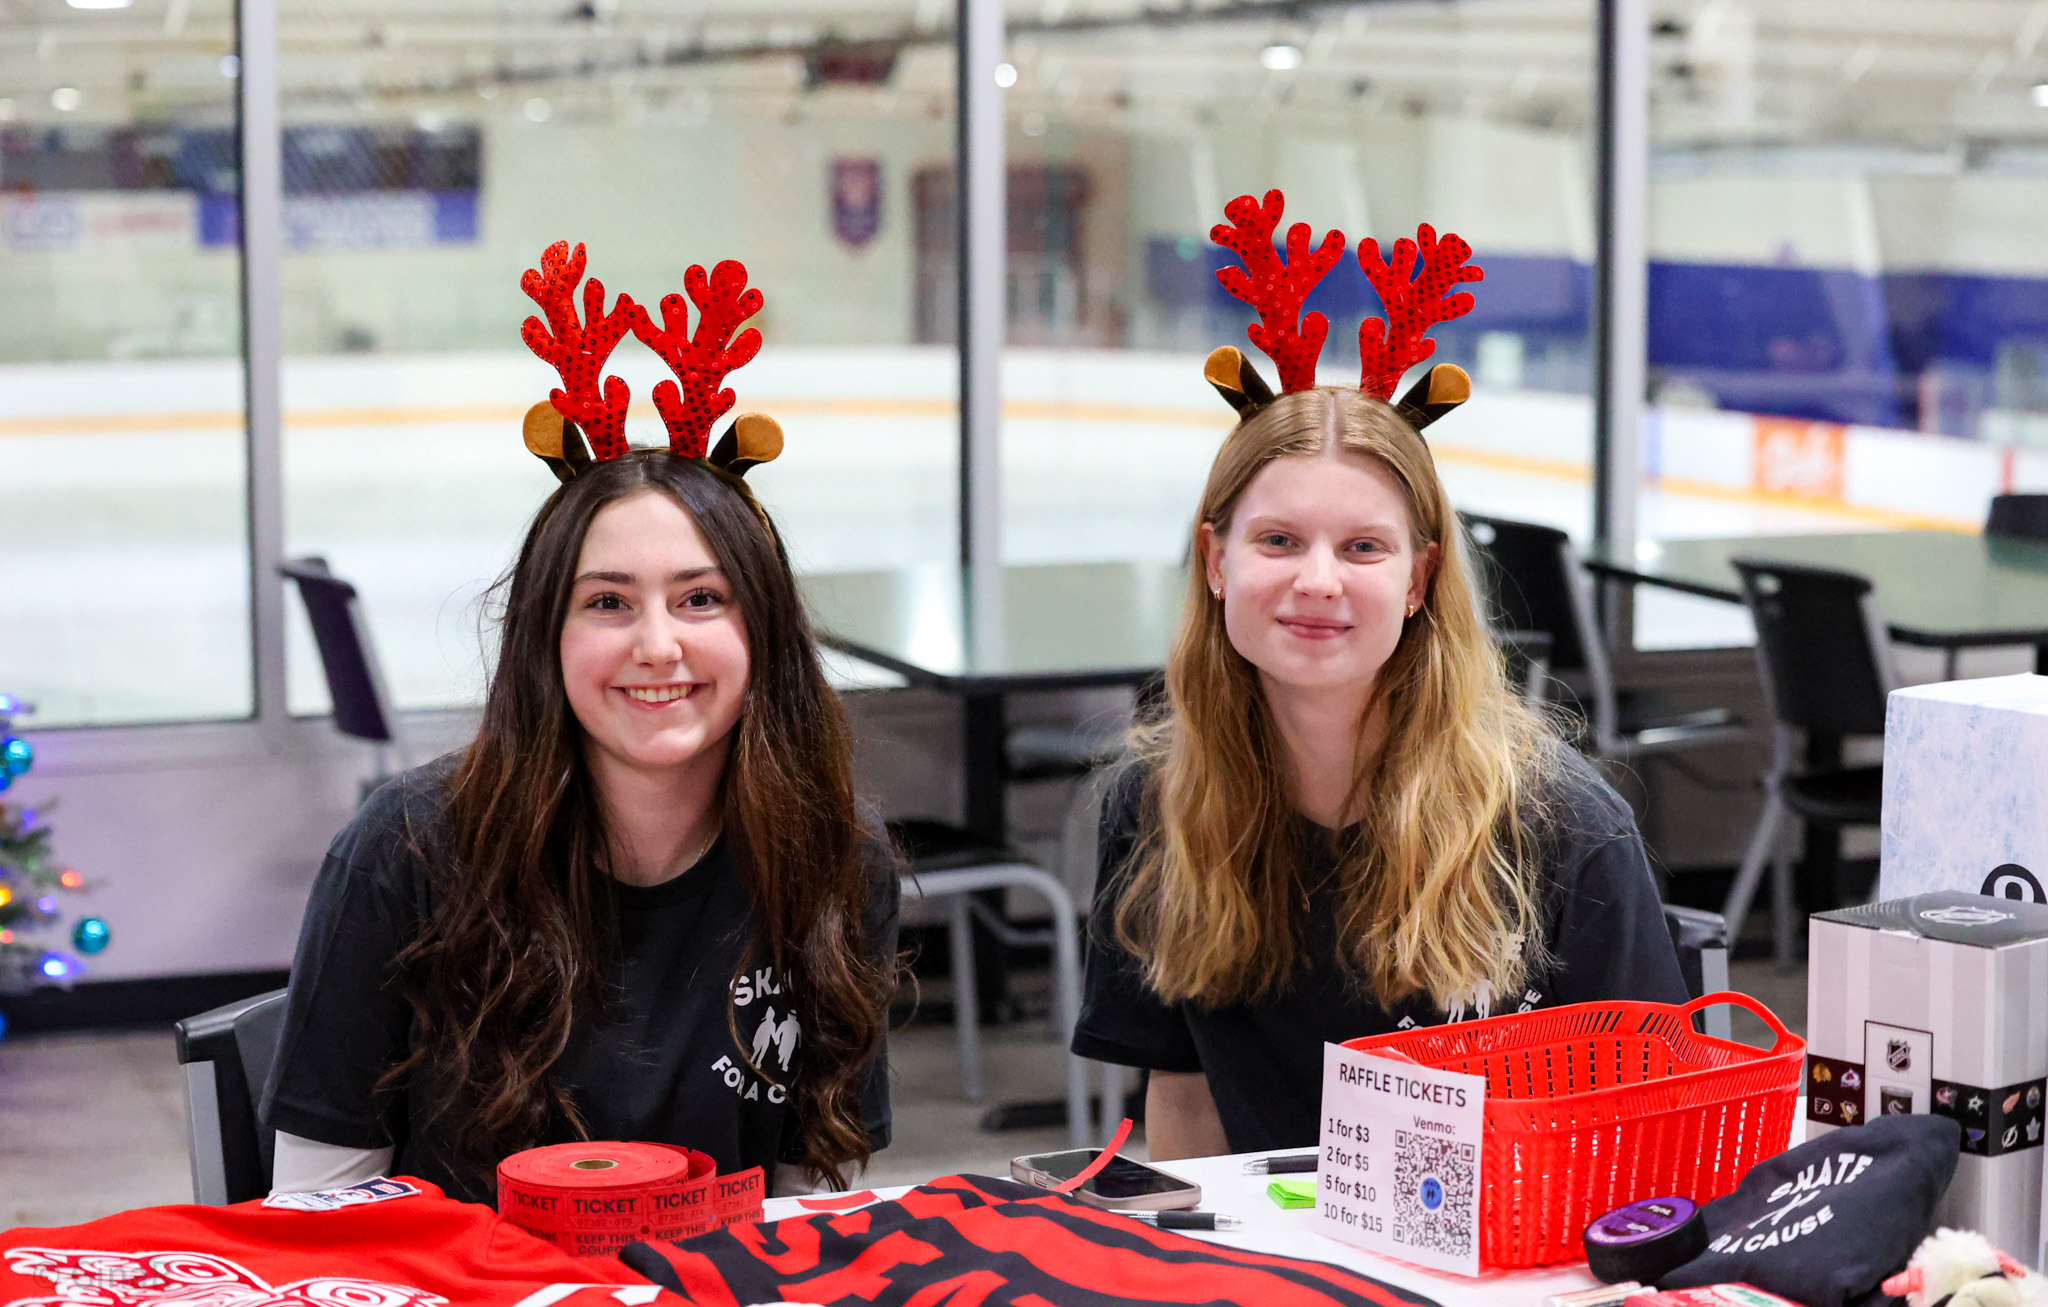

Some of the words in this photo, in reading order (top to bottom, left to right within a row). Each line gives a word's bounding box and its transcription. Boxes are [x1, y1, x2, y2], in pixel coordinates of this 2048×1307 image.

[744, 1081, 758, 1101] A
[1340, 1063, 1391, 1093] RAFFLE
[1395, 1076, 1466, 1108] TICKETS
[1328, 1118, 1334, 1133] 1
[1337, 1119, 1353, 1138] for
[1355, 1123, 1370, 1143] $3
[1413, 1115, 1456, 1135] Venmo:
[1327, 1146, 1333, 1161] 2
[1336, 1147, 1352, 1166] for
[1355, 1152, 1369, 1171] $5
[719, 1174, 761, 1198] TICKET
[1325, 1174, 1332, 1190] 5
[1335, 1176, 1351, 1195] for
[1354, 1181, 1376, 1202] $10
[1766, 1152, 1874, 1203] SKATE
[511, 1189, 558, 1211] TICKET
[573, 1198, 637, 1213] TICKET
[653, 1187, 707, 1210] TICKET
[720, 1214, 743, 1228] KEEP
[744, 1209, 761, 1222] THIS
[1324, 1203, 1338, 1220] 10
[1341, 1207, 1358, 1226] for
[1361, 1211, 1383, 1233] $15
[1743, 1205, 1835, 1253] CAUSE
[535, 1230, 558, 1243] THIS
[575, 1234, 606, 1244] KEEP
[609, 1233, 636, 1243] THIS
[655, 1228, 683, 1241] KEEP
[686, 1223, 707, 1235] THIS
[578, 1245, 624, 1255] COUPO
